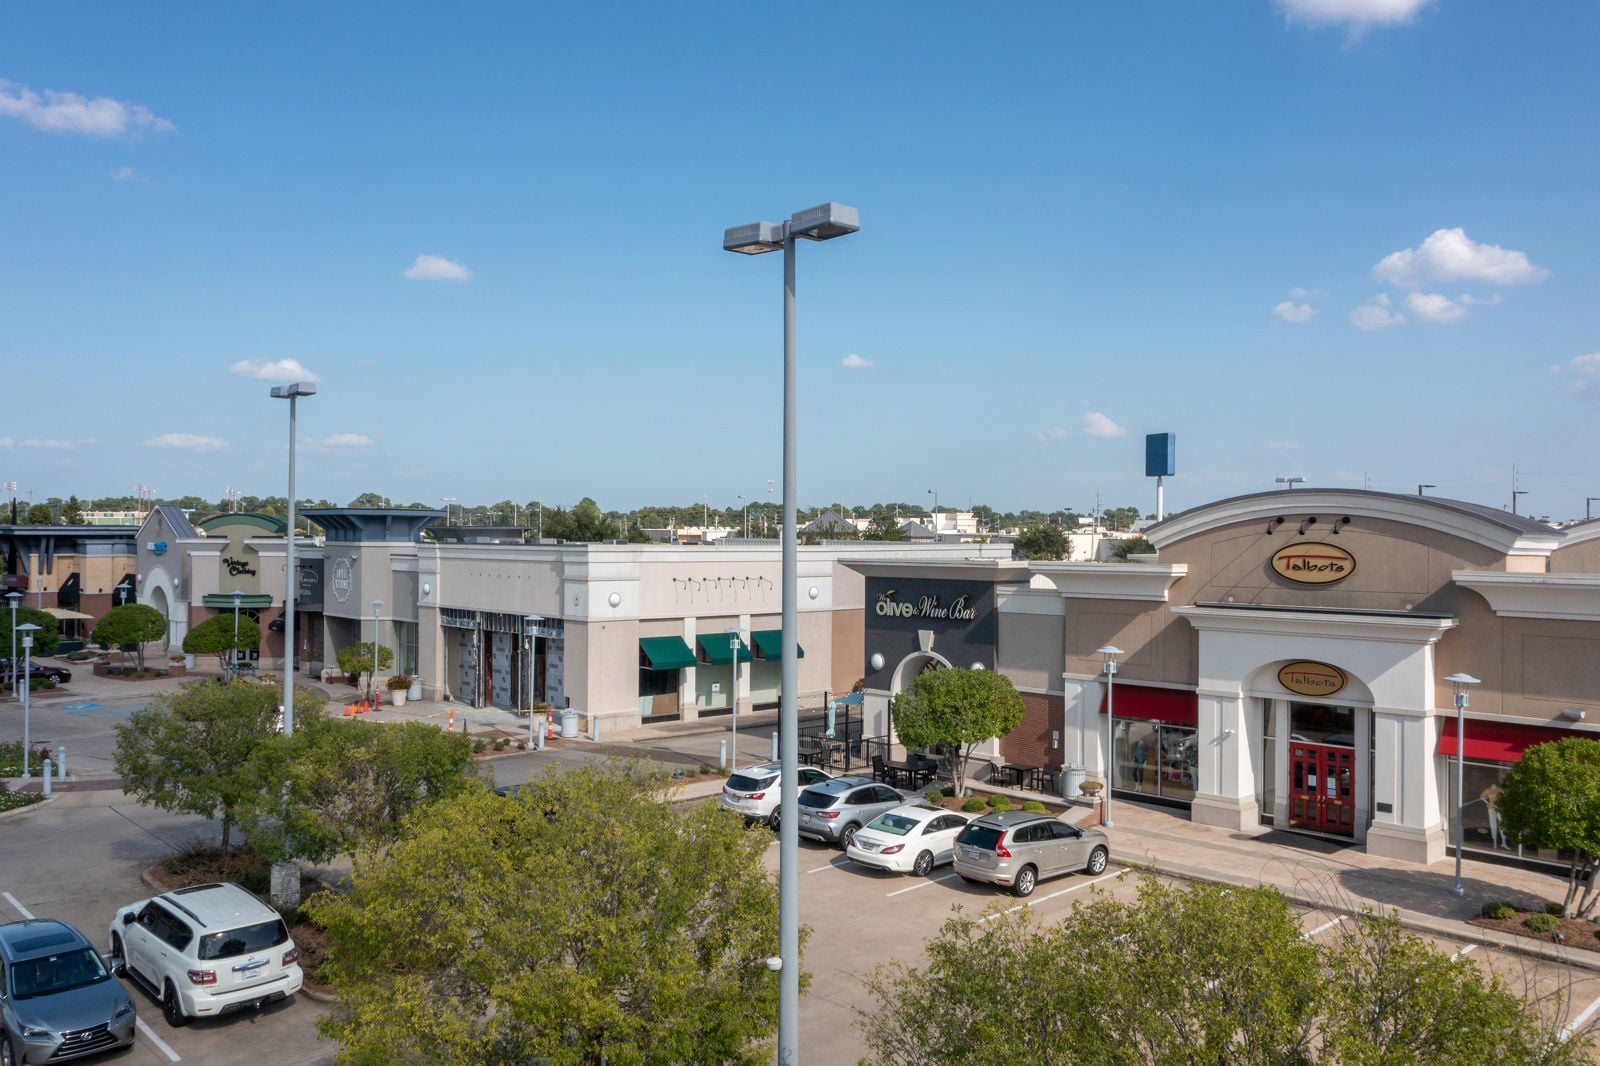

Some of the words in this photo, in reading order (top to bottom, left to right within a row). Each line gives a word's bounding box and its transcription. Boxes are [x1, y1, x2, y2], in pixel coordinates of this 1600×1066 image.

[229, 566, 256, 577] Clothing
[1277, 554, 1348, 573] Talbots
[913, 606, 920, 615] &
[918, 594, 948, 618] Wine
[949, 594, 977, 620] Bar
[1284, 671, 1338, 688] Talbots
